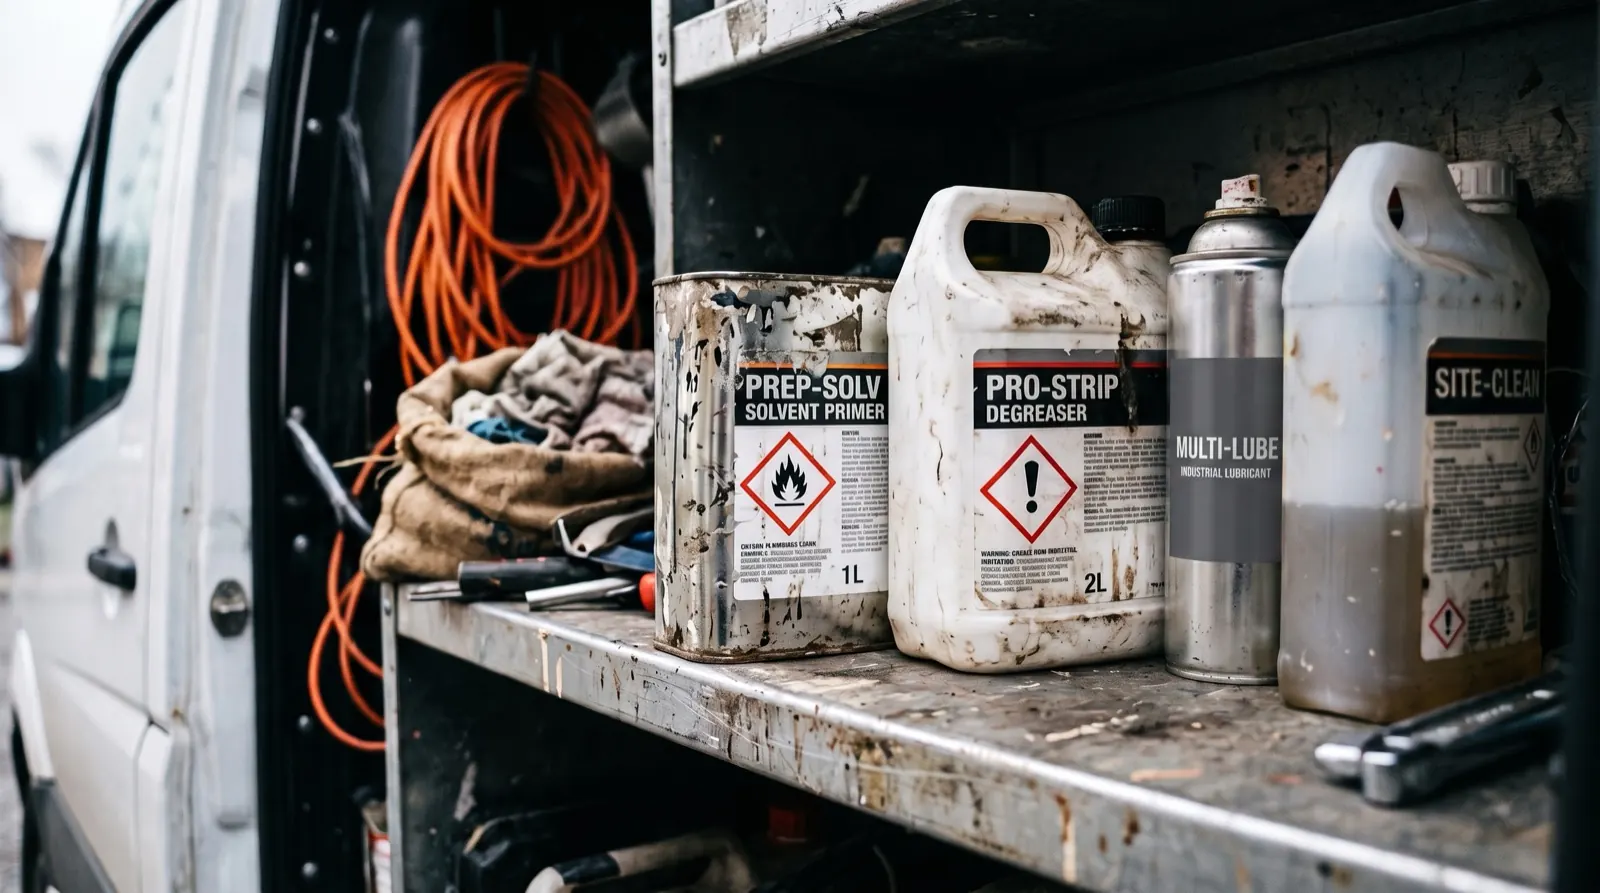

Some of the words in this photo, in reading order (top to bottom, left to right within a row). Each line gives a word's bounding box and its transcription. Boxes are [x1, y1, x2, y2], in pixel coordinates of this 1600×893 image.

[745, 374, 881, 400] PREP-SOLV
[986, 374, 1119, 401] PRO-STRIP
[1434, 367, 1540, 398] SITE-CLEAN
[745, 403, 820, 421] SOLVENT
[825, 403, 885, 420] PRIMER
[986, 404, 1087, 423] DEGREASER
[1176, 435, 1279, 460] MULTI-LUBE
[1180, 466, 1223, 478] INDUSTRIAL
[1224, 467, 1272, 479] LUBRICANT
[841, 564, 864, 585] 1L
[1084, 572, 1107, 594] 2L
